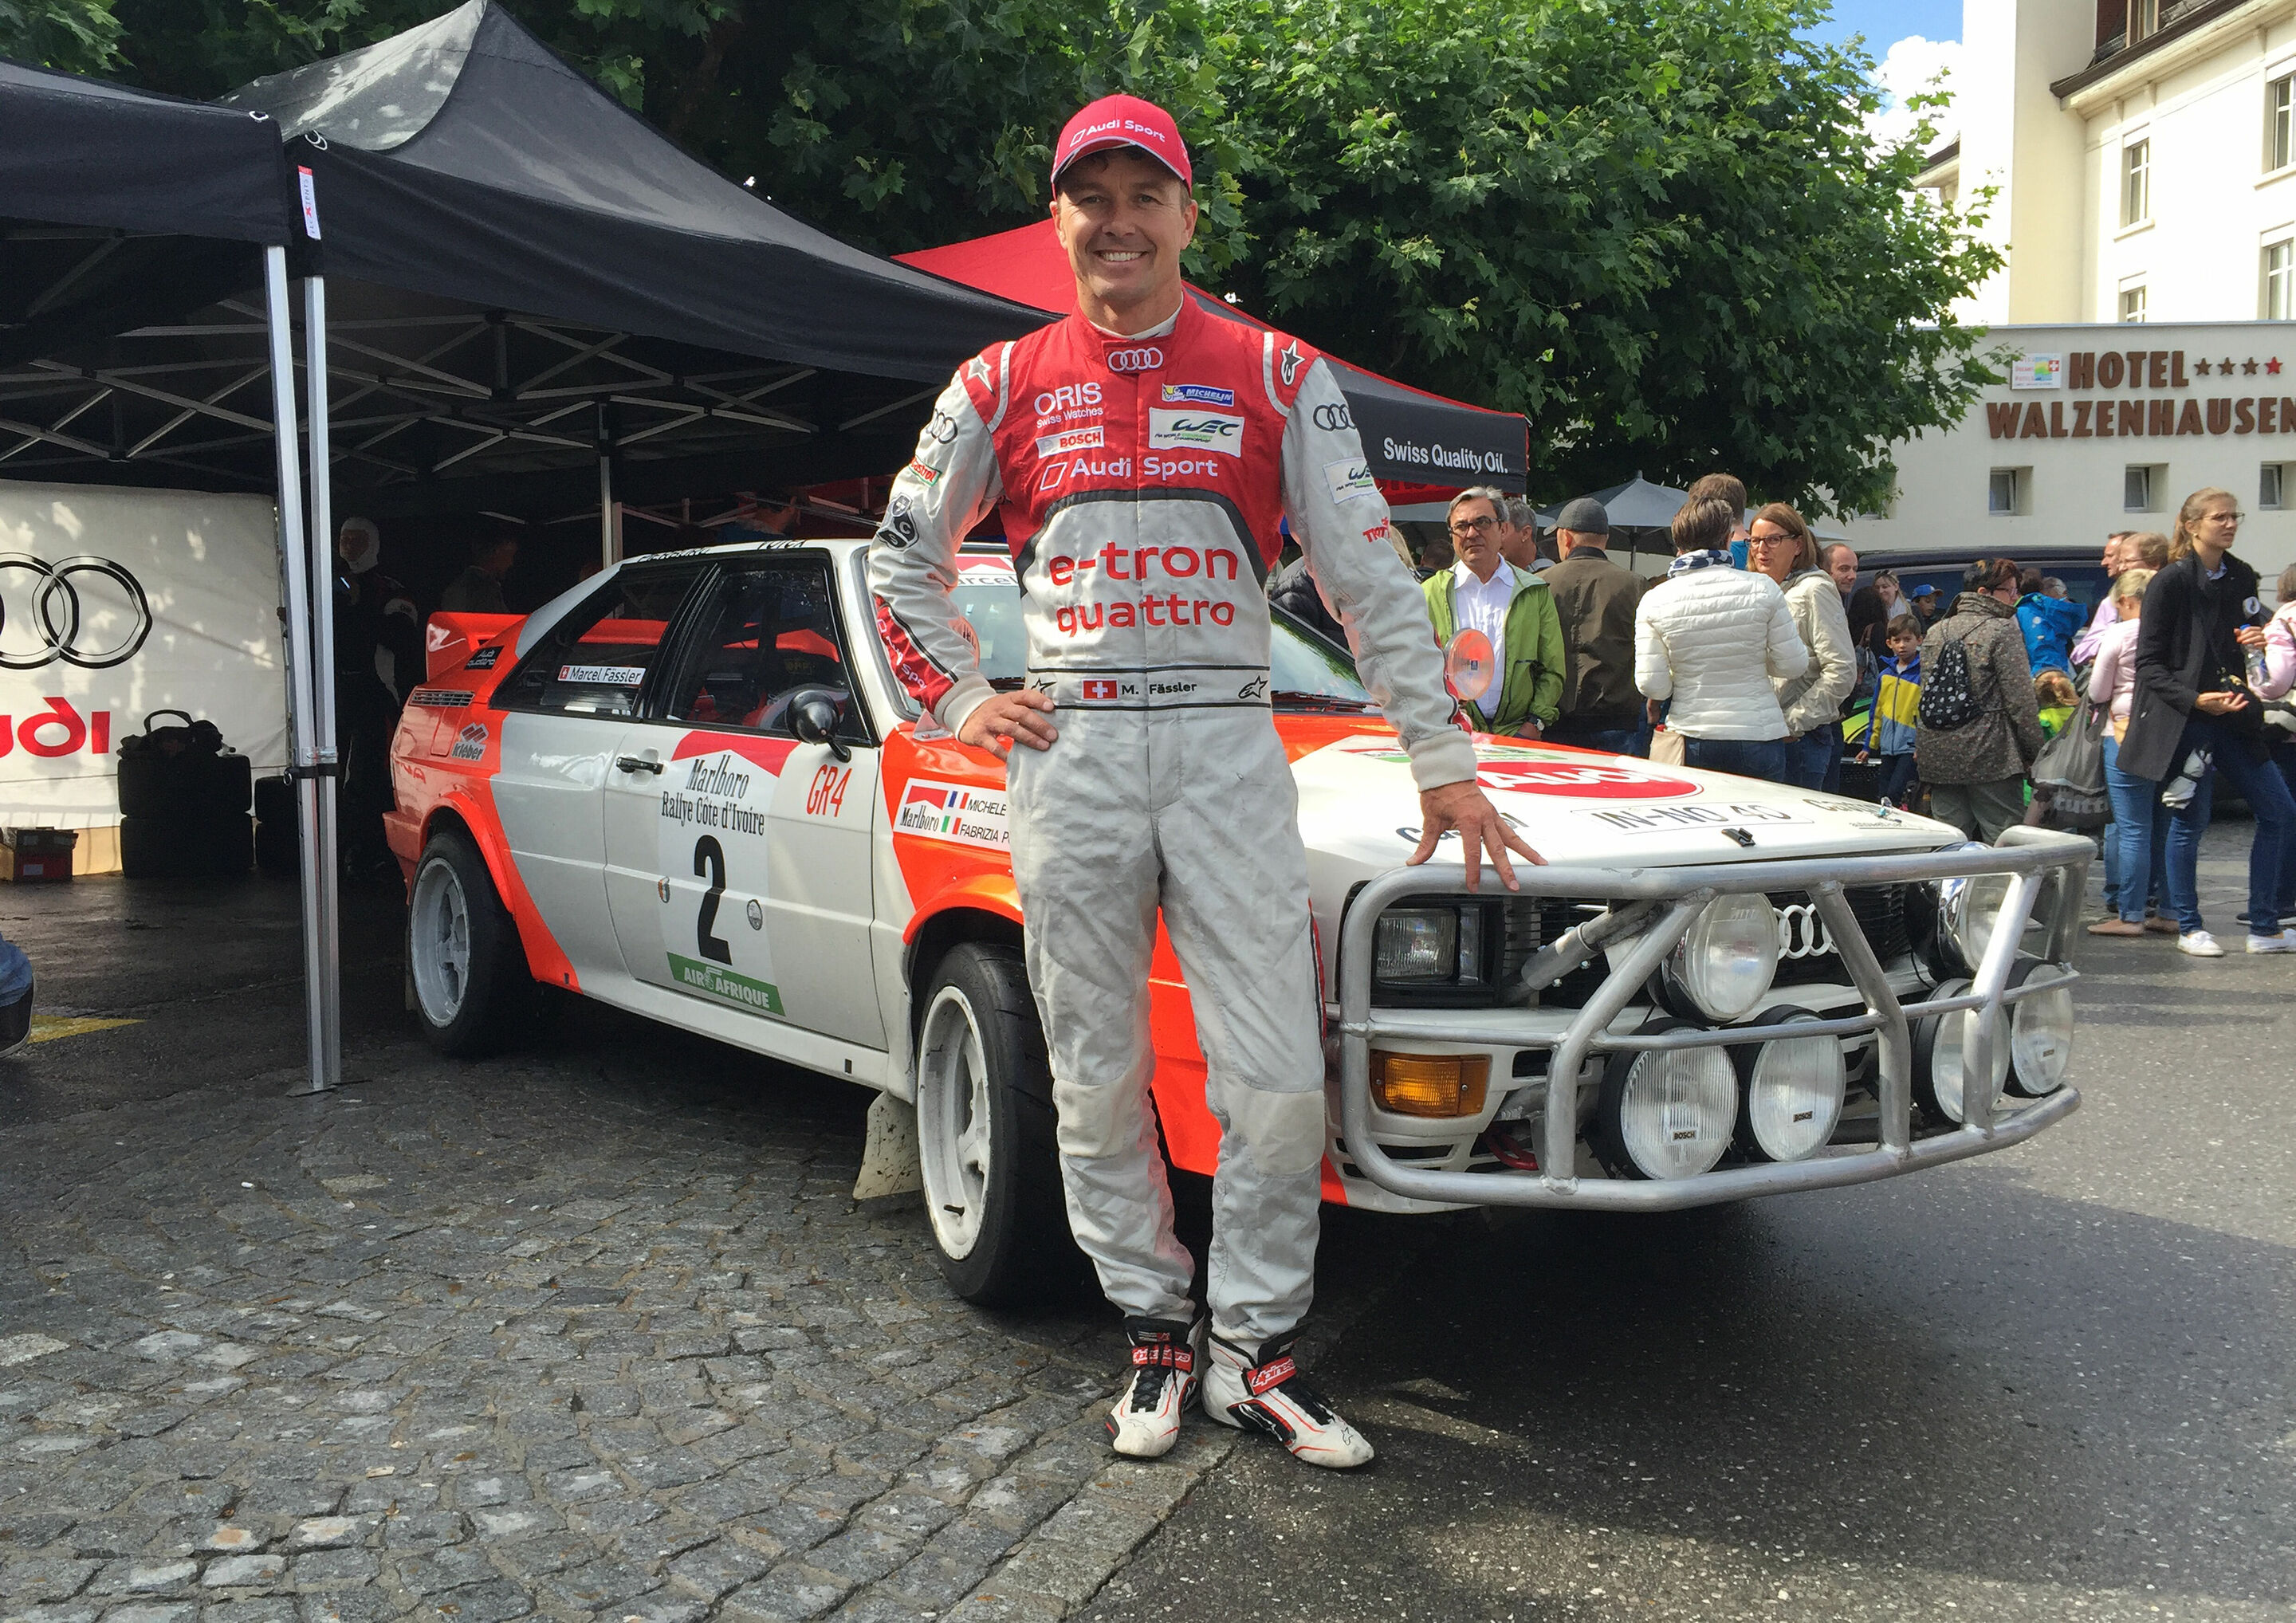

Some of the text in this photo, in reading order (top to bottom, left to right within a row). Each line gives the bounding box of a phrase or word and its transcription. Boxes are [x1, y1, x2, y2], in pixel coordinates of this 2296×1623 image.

[1086, 119, 1166, 143] Audi Sport
[2068, 351, 2189, 389] HOTEL
[1034, 382, 1103, 416] ORIS
[1185, 388, 1233, 402] MICHELIN
[1036, 407, 1104, 429] Swiss Watches
[1172, 419, 1240, 437] WEC
[1986, 397, 2296, 438] WALZENHAUSEN
[1060, 431, 1101, 448] BOSCH
[1070, 456, 1218, 481] Audi Sport
[1383, 437, 1508, 475] Swiss Quality Oil.
[1049, 540, 1238, 587] e-tron
[1056, 593, 1235, 638] quattro
[568, 666, 641, 684] Marcel Fässler
[1121, 682, 1197, 695] M. Fässler
[0, 696, 110, 758] di
[686, 754, 749, 800] Marlboro
[807, 764, 852, 818] GR4
[662, 791, 765, 836] Rallye Côte d'Ivoire
[899, 805, 940, 832] Marlboro
[967, 799, 1007, 816] MICHELE
[1591, 804, 1791, 829] IN-NO 40
[958, 823, 999, 843] FABRIZIA
[694, 835, 733, 966] 2
[683, 967, 770, 1008] AIR AFRIQUE
[1794, 1110, 1813, 1122] BOSCH
[1673, 1130, 1696, 1140] BOSCH
